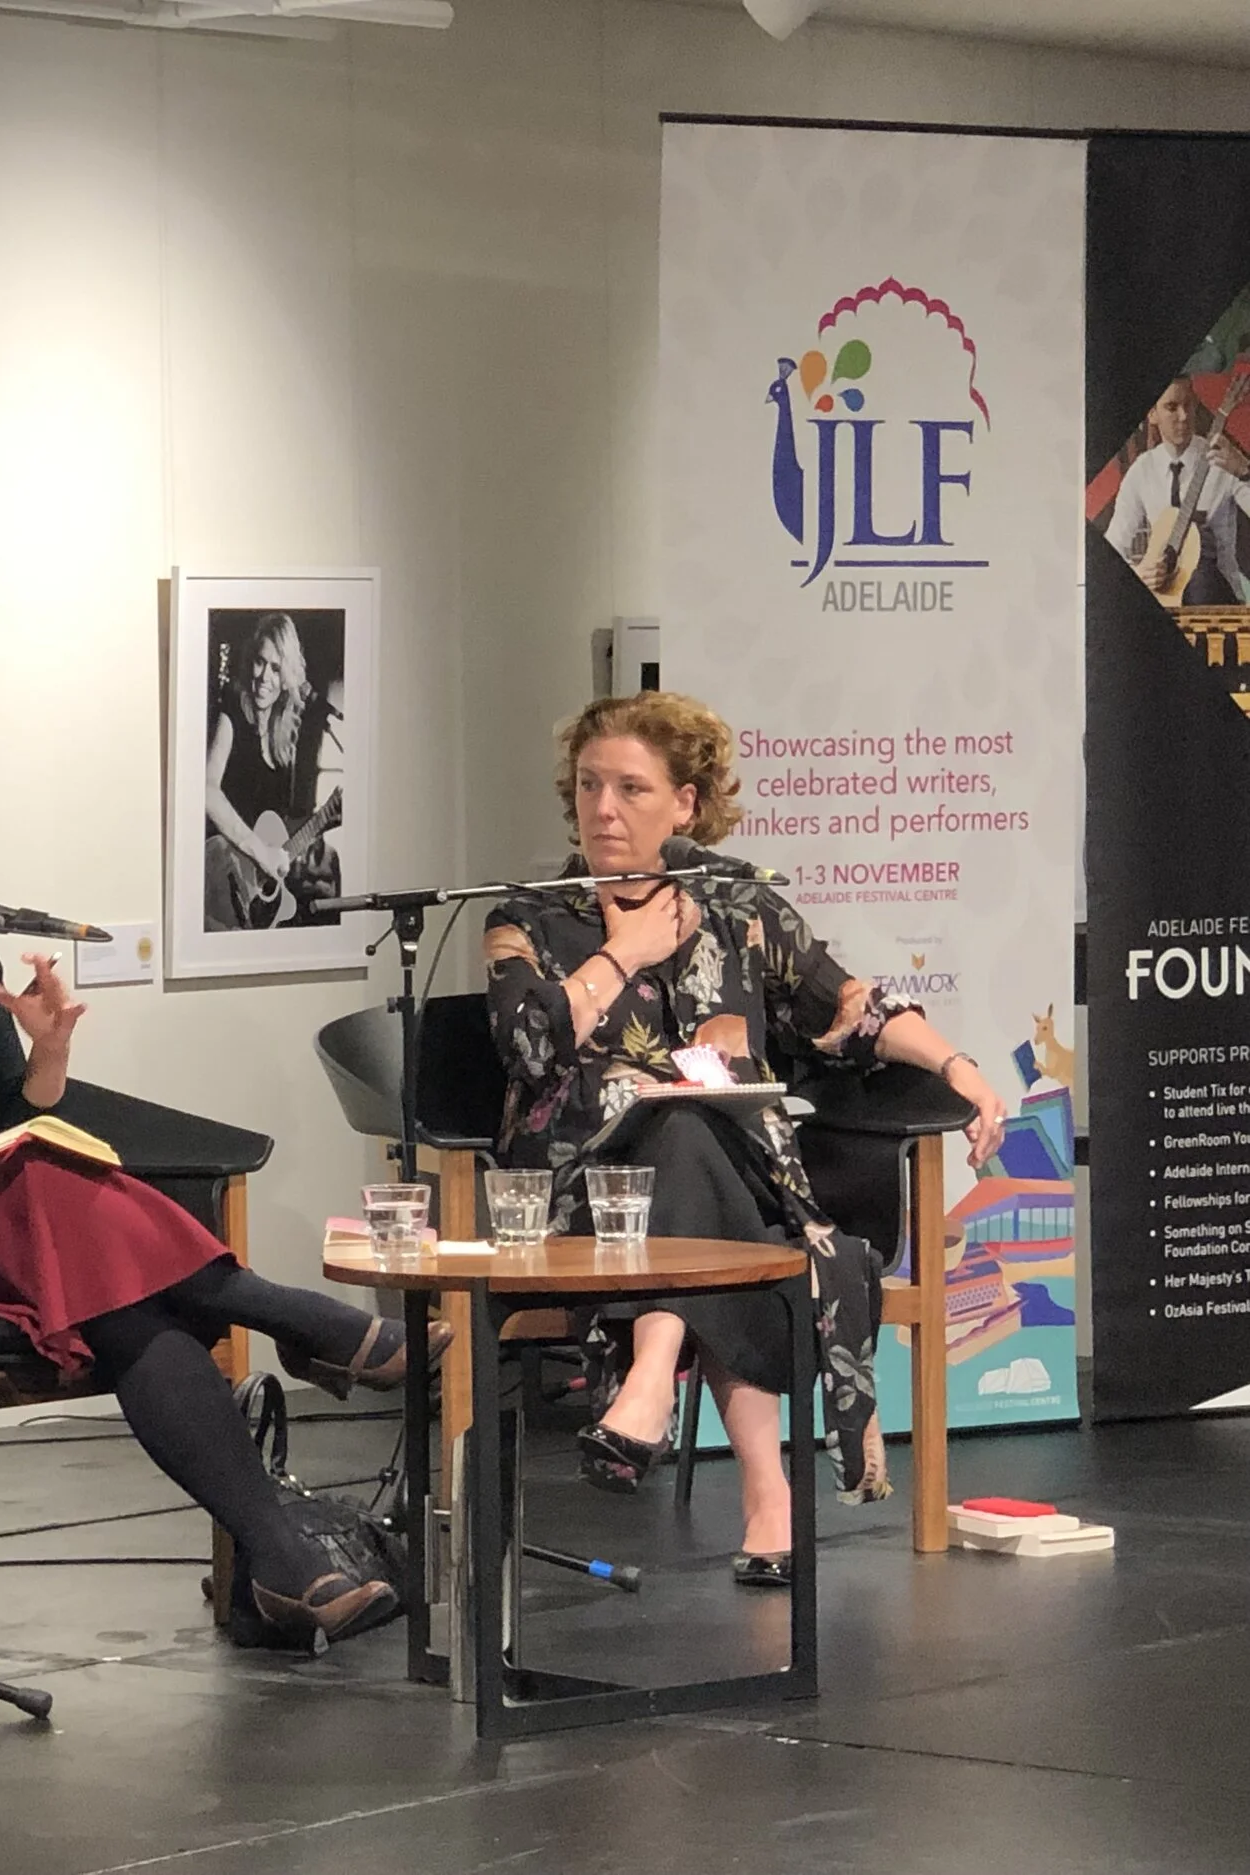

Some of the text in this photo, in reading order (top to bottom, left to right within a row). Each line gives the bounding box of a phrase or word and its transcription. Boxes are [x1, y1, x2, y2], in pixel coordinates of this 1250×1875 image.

[800, 419, 974, 588] JLF
[822, 581, 953, 612] ADELAIDE
[738, 727, 1014, 764] Showcasing the most
[756, 766, 997, 797] celebrated writers,
[828, 805, 880, 834] and
[890, 804, 1029, 841] performers
[795, 862, 960, 886] 1-3 NOVEMBER
[795, 888, 958, 905] ADELAIDE FESTIVAL CENTRE
[1147, 916, 1249, 937] ADELAIDE FE
[1148, 1045, 1250, 1067] SUPPORTS PR
[1163, 1082, 1246, 1100] Student Tix for
[1163, 1106, 1176, 1119] to
[1177, 1102, 1214, 1118] attend
[1216, 1101, 1236, 1116] live
[1163, 1133, 1231, 1149] GreenRoom
[1163, 1163, 1213, 1179] Adelaide
[1164, 1192, 1232, 1209] Fellowships
[1164, 1222, 1226, 1240] Something
[1228, 1224, 1242, 1236] on
[1164, 1241, 1228, 1258] Foundation
[1164, 1273, 1187, 1289] Her
[1189, 1269, 1242, 1289] Majesty's
[1164, 1298, 1250, 1318] OzAsia Festival
